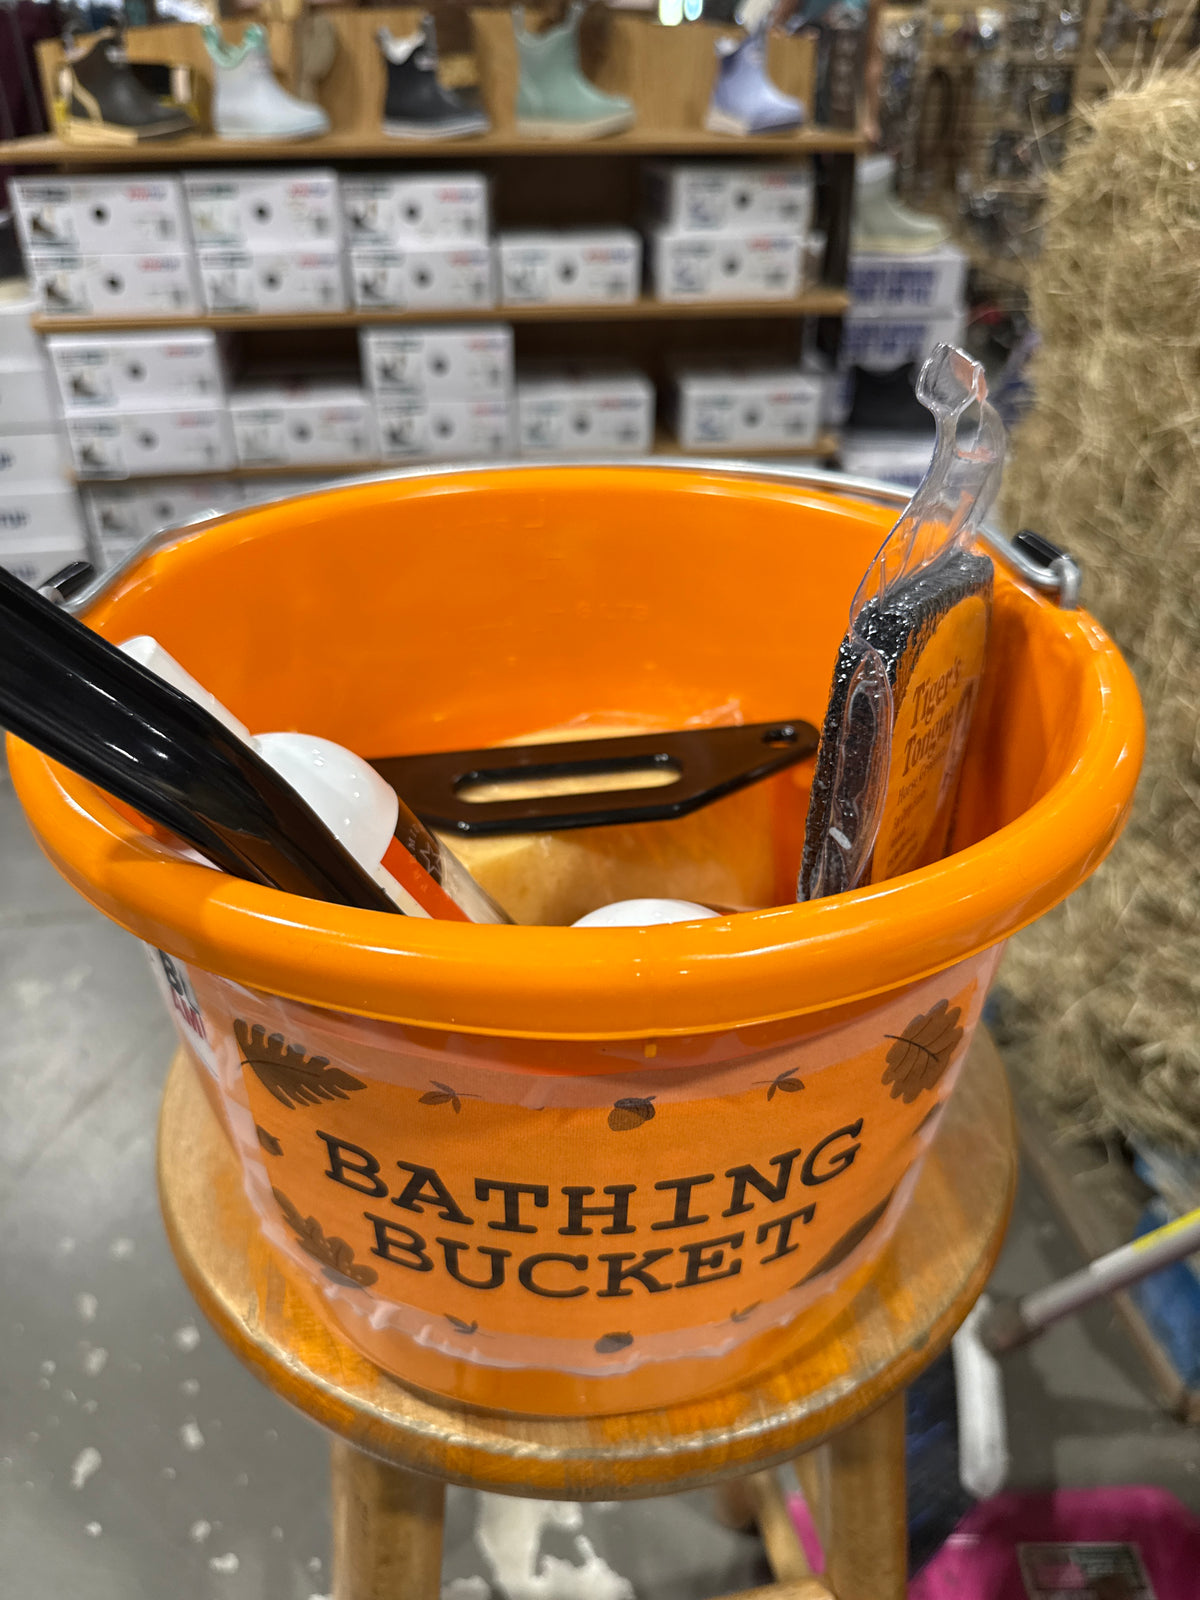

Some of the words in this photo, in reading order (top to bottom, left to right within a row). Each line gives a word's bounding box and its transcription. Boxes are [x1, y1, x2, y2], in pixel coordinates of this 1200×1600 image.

[911, 655, 962, 730] Tiger's
[316, 1118, 864, 1236] BATHING
[363, 1202, 817, 1299] BUCKET
